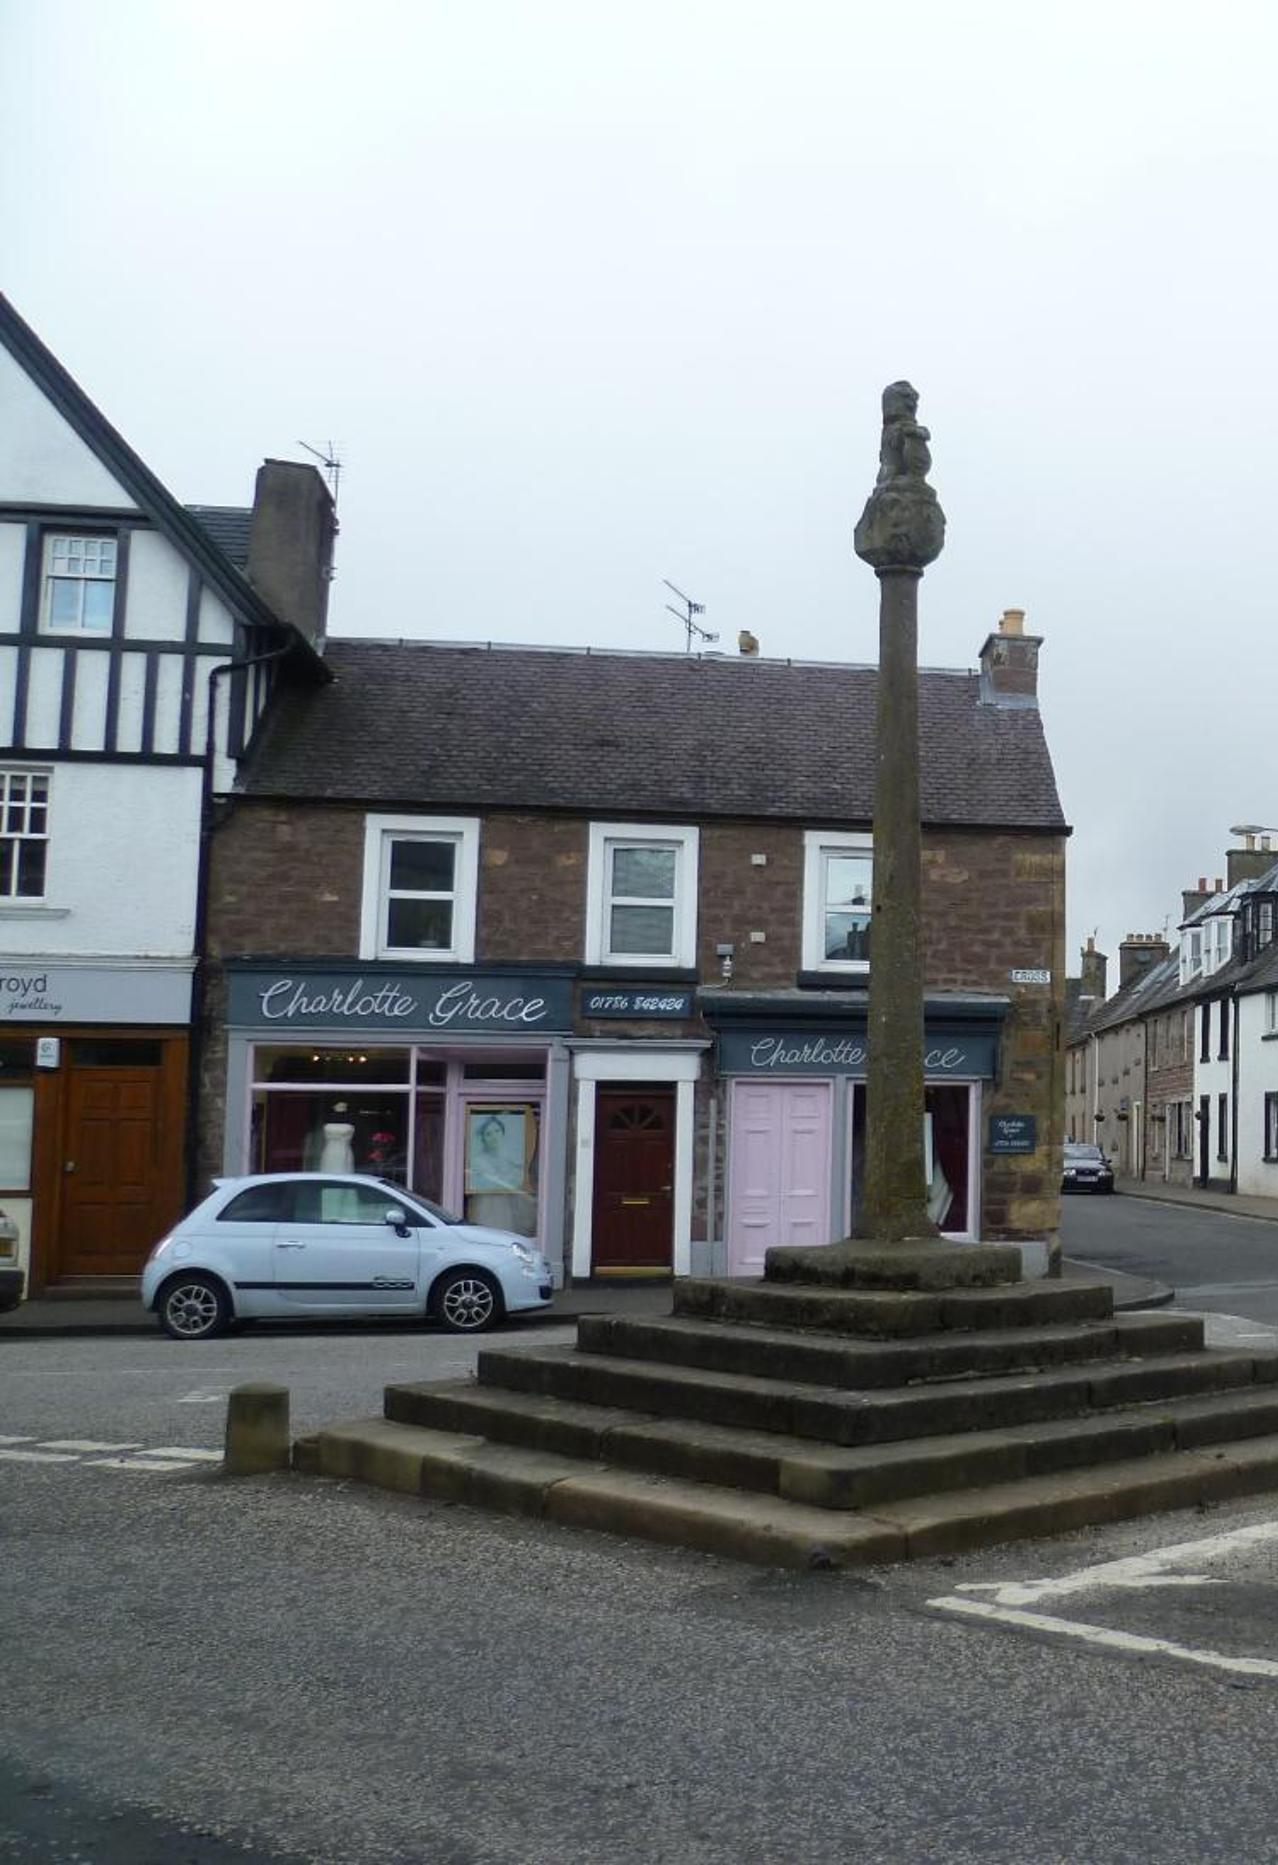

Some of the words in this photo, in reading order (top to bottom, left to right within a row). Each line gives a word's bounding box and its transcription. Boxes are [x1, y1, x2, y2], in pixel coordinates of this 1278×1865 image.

[9, 997, 62, 1016] jewellery
[259, 979, 419, 1019] Charlotte
[428, 981, 547, 1026] Grace
[590, 996, 628, 1010] 01786
[633, 996, 685, 1011] 842424
[751, 1037, 867, 1067] Charlotte
